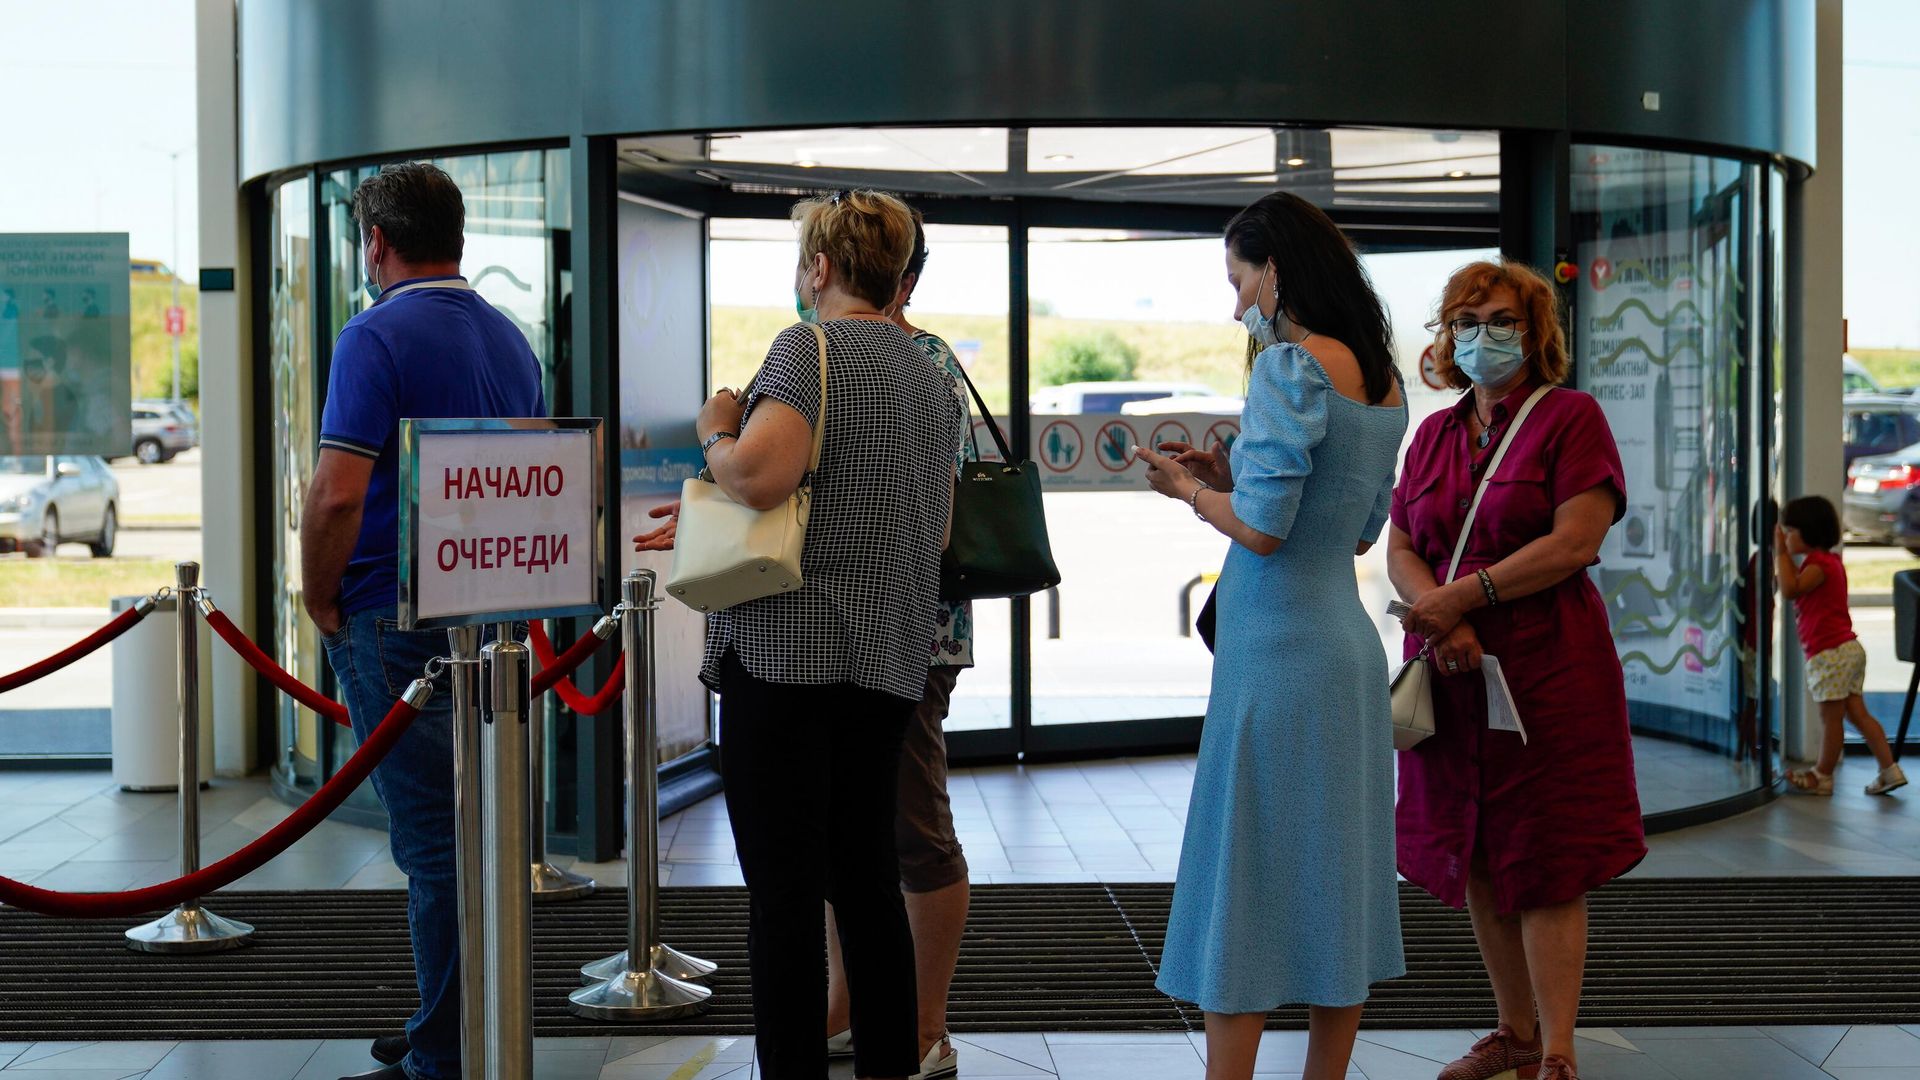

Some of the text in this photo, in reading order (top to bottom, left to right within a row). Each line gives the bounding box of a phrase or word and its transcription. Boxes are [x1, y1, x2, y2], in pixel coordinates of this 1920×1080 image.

[1590, 359, 1649, 378] КОМПАКТНЫЙ
[1591, 384, 1645, 400] ФИТНЕС-ЗАЛ
[444, 465, 563, 499] НАЧАЛО
[437, 534, 568, 574] ОЧЕРЕДИ
